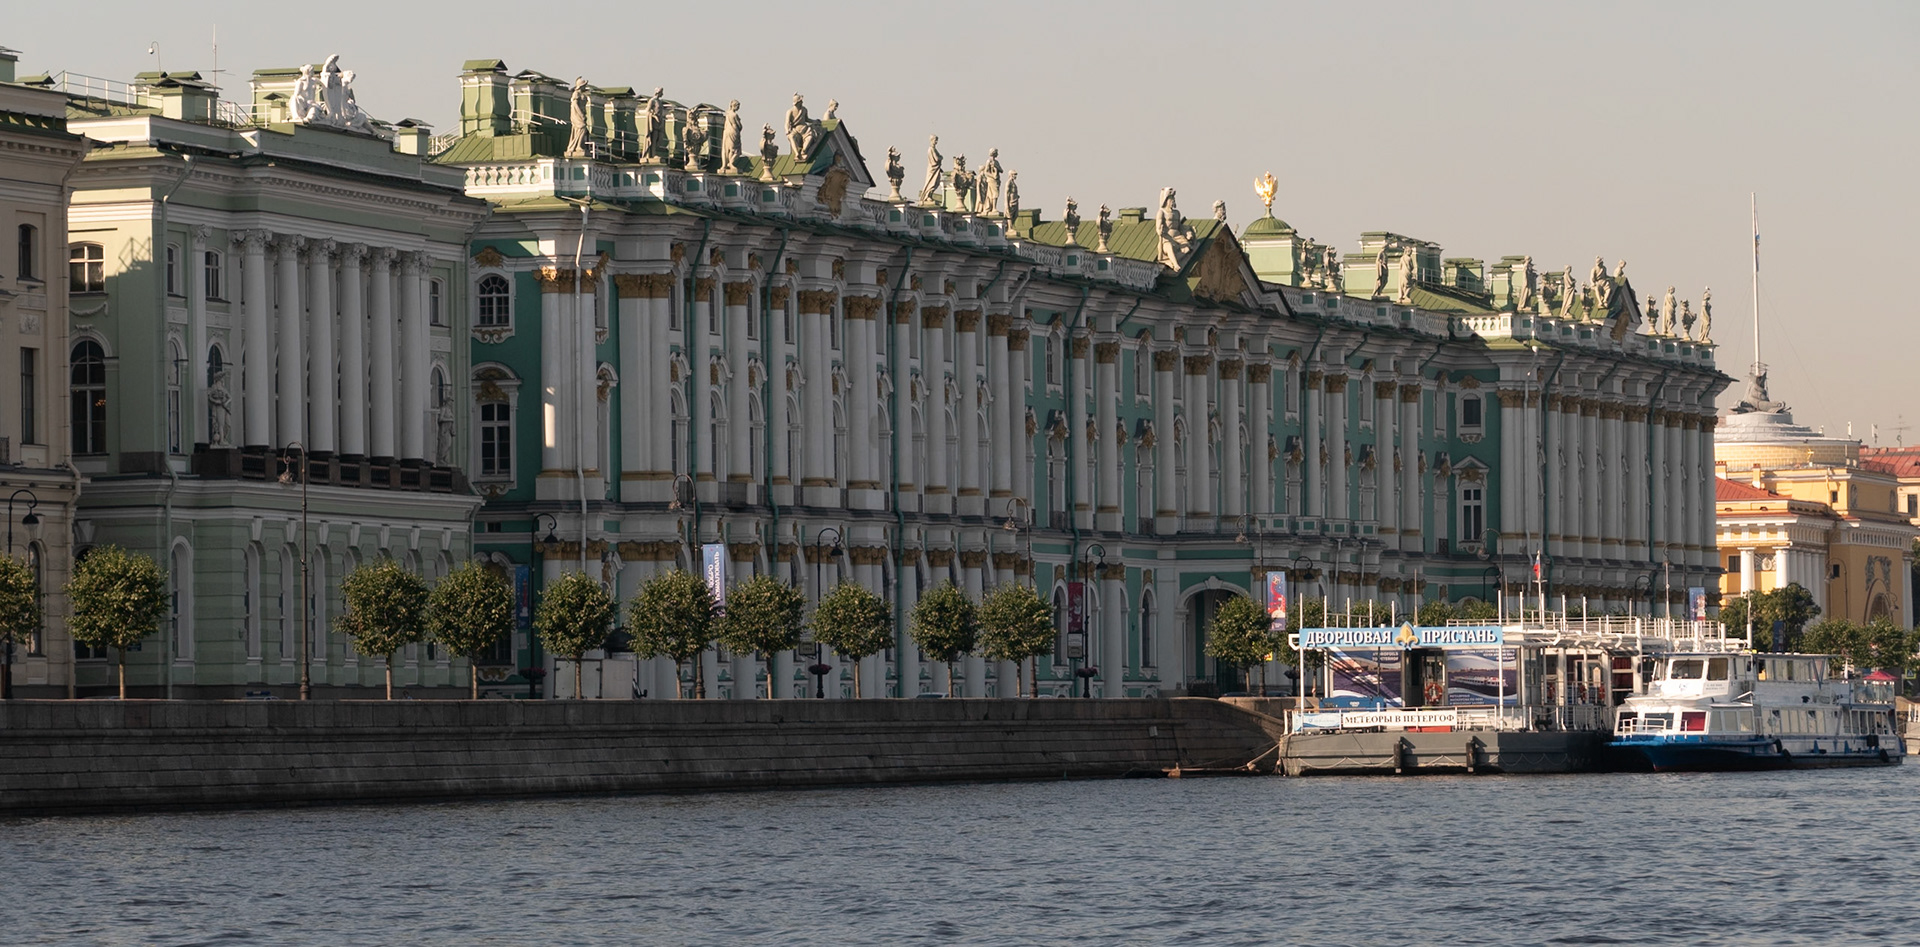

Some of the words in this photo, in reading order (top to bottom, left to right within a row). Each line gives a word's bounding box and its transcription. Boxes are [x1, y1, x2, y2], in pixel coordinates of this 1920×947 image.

[1306, 631, 1393, 647] ДВОРЦОВАЯ
[1421, 629, 1497, 643] ПРИСТАНЬ
[1345, 715, 1392, 723] МЕТЕОРЫ
[1403, 714, 1455, 723] ПЕТЕРГОФ
